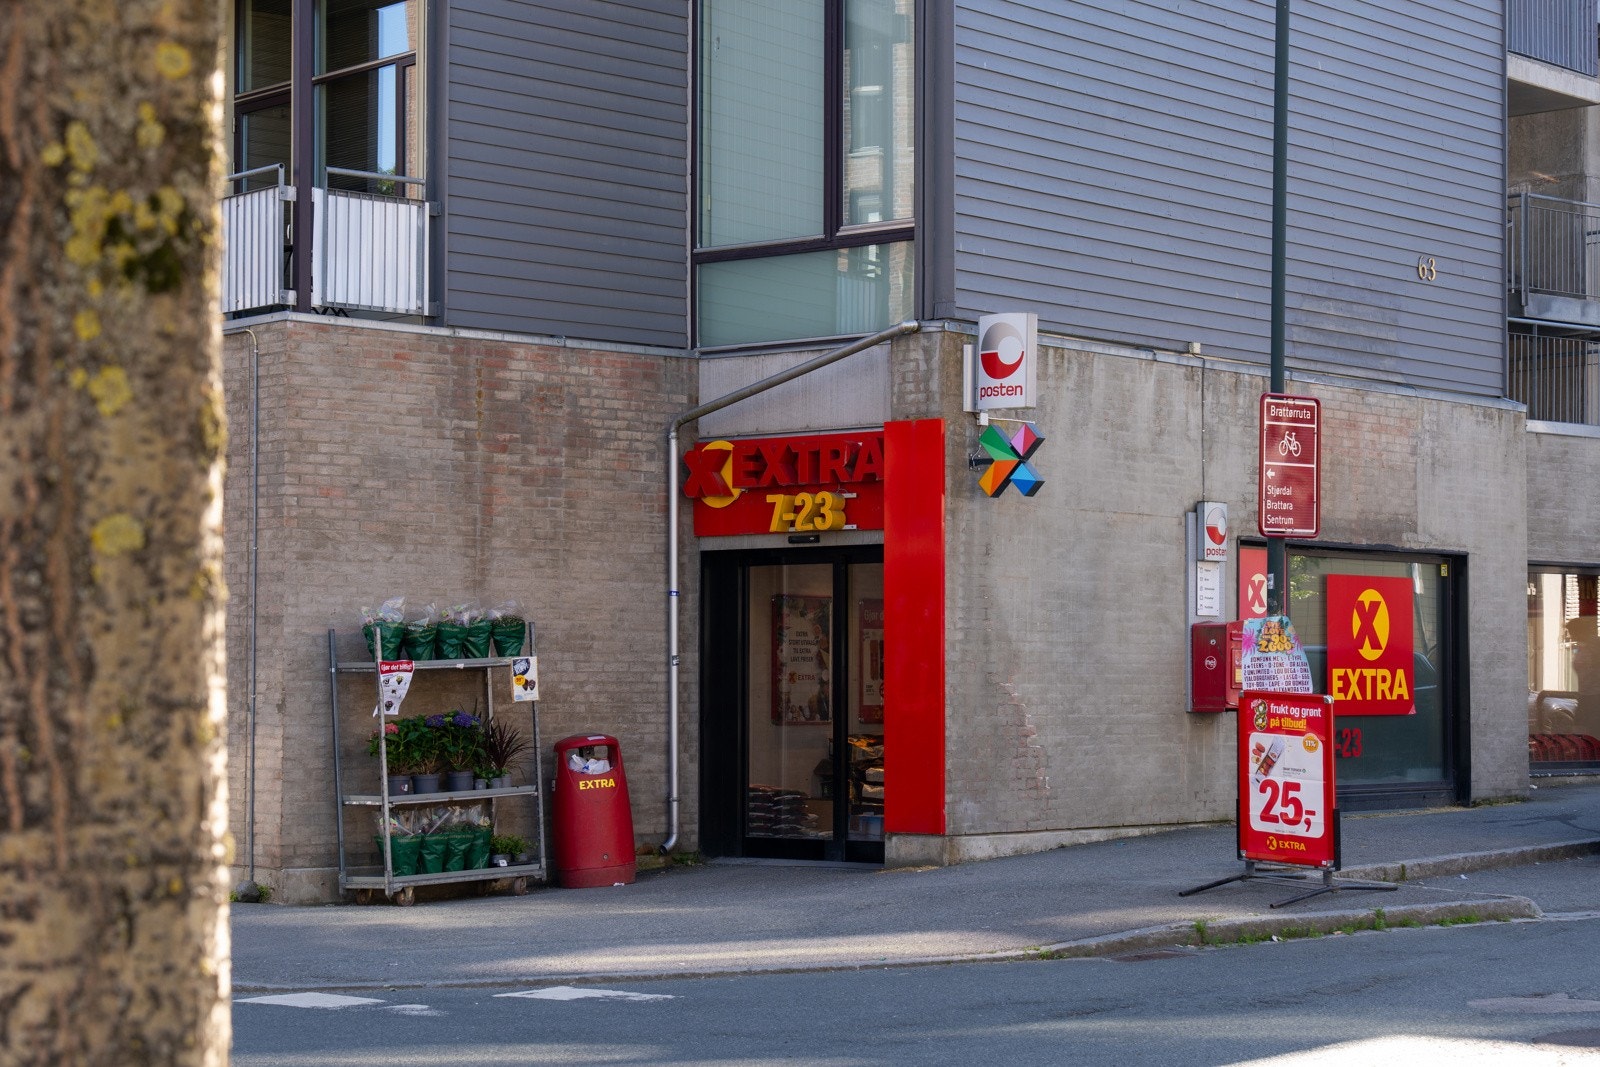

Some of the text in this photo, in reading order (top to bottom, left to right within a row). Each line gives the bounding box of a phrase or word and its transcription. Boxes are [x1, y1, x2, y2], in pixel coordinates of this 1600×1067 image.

[1418, 256, 1436, 281] 63
[980, 383, 1023, 400] posten
[1270, 405, 1310, 419] Brattørruta
[732, 438, 884, 489] EXTRA
[1267, 485, 1292, 497] Stjørdal
[766, 491, 843, 532] 7-23
[1266, 500, 1293, 510] Brattøra
[1266, 515, 1294, 525] Sentrum
[1332, 668, 1410, 701] EXTRA
[1270, 703, 1288, 714] frukt
[1290, 708, 1300, 718] og
[1301, 707, 1321, 718] grønt
[1270, 717, 1306, 729] på tilbud!
[1334, 727, 1362, 758] -23
[579, 778, 616, 790] EXTRA
[1280, 840, 1306, 851] EXTRA
